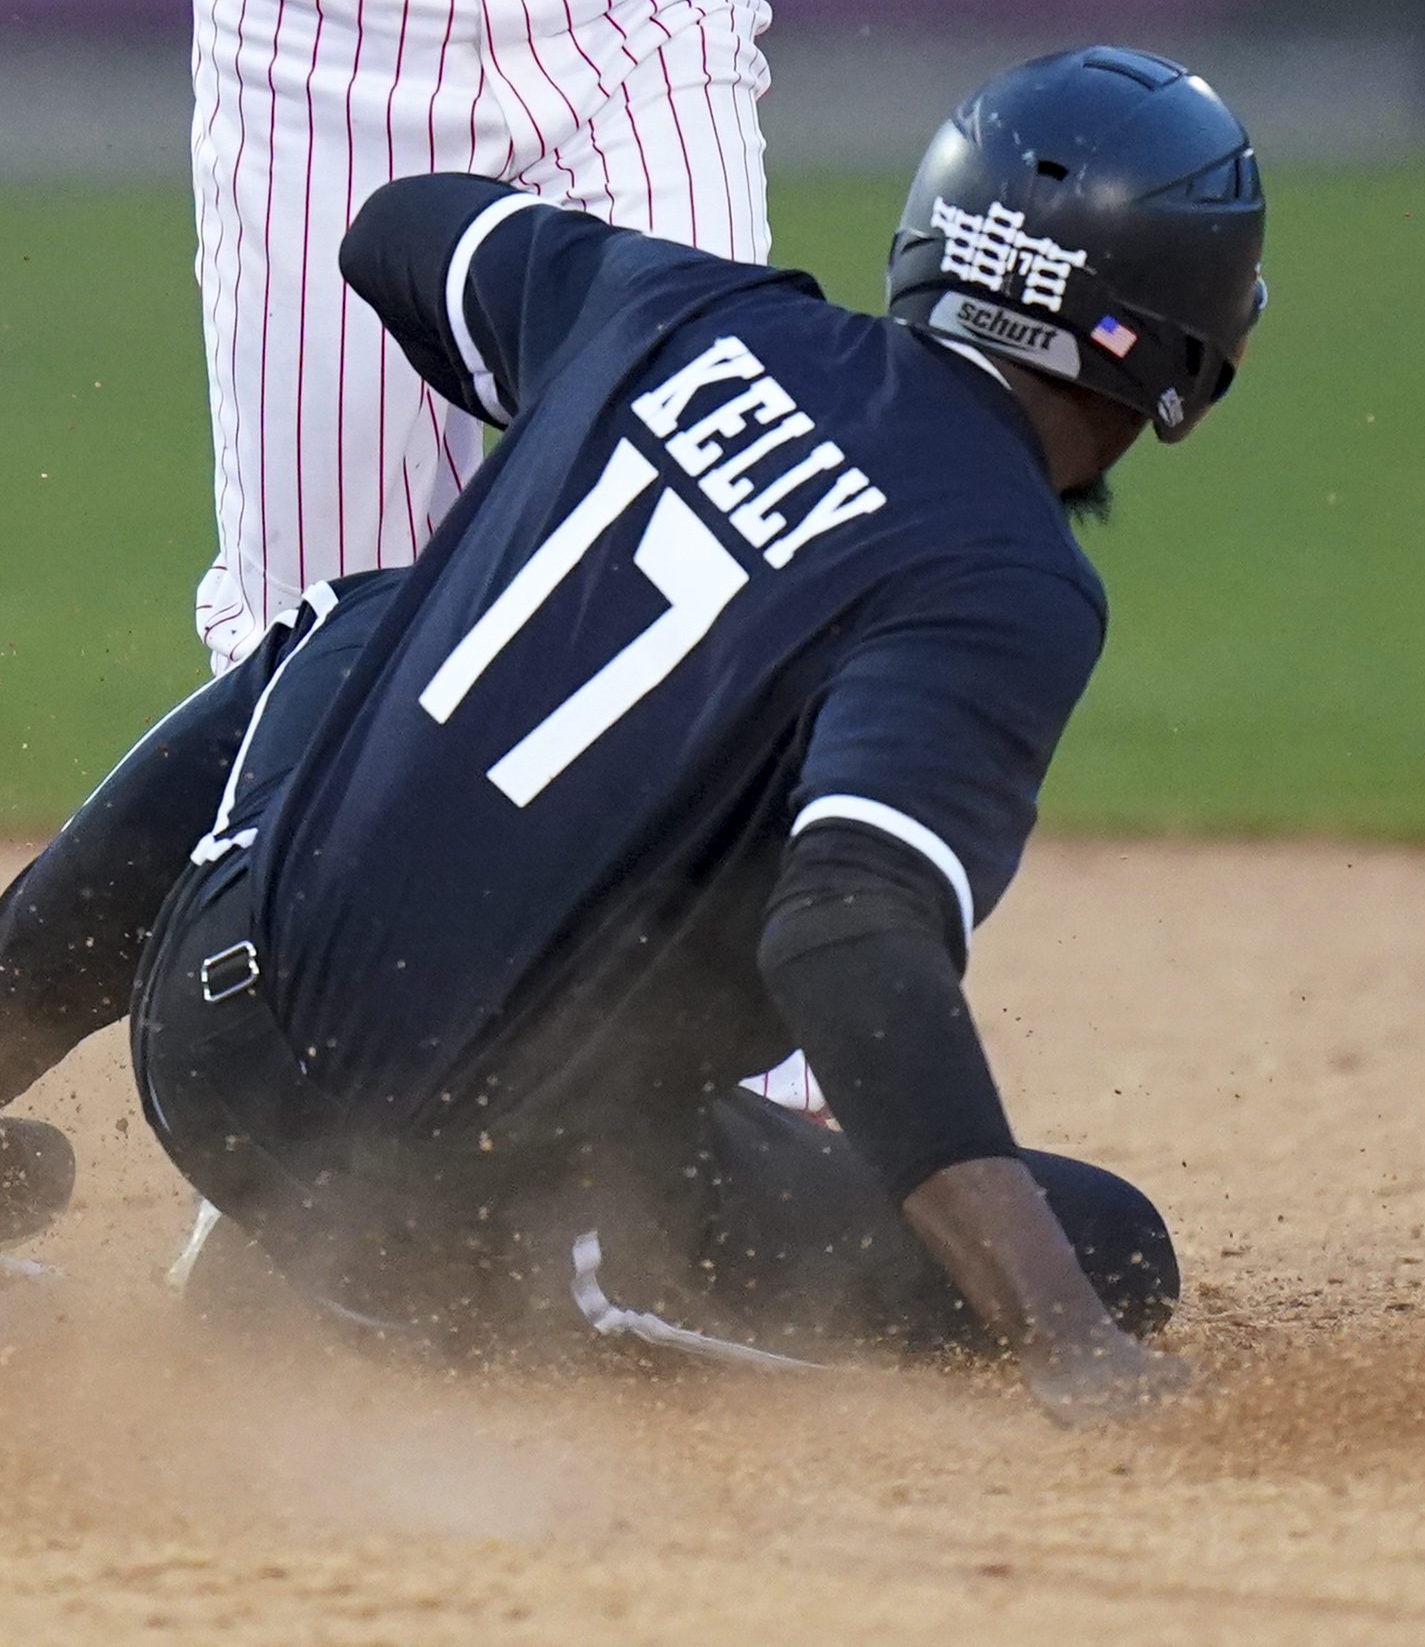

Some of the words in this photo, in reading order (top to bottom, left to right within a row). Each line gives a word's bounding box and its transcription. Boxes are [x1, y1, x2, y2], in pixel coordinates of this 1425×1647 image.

[957, 301, 1058, 350] schutt
[631, 336, 887, 569] KELLY
[418, 437, 750, 808] 17
